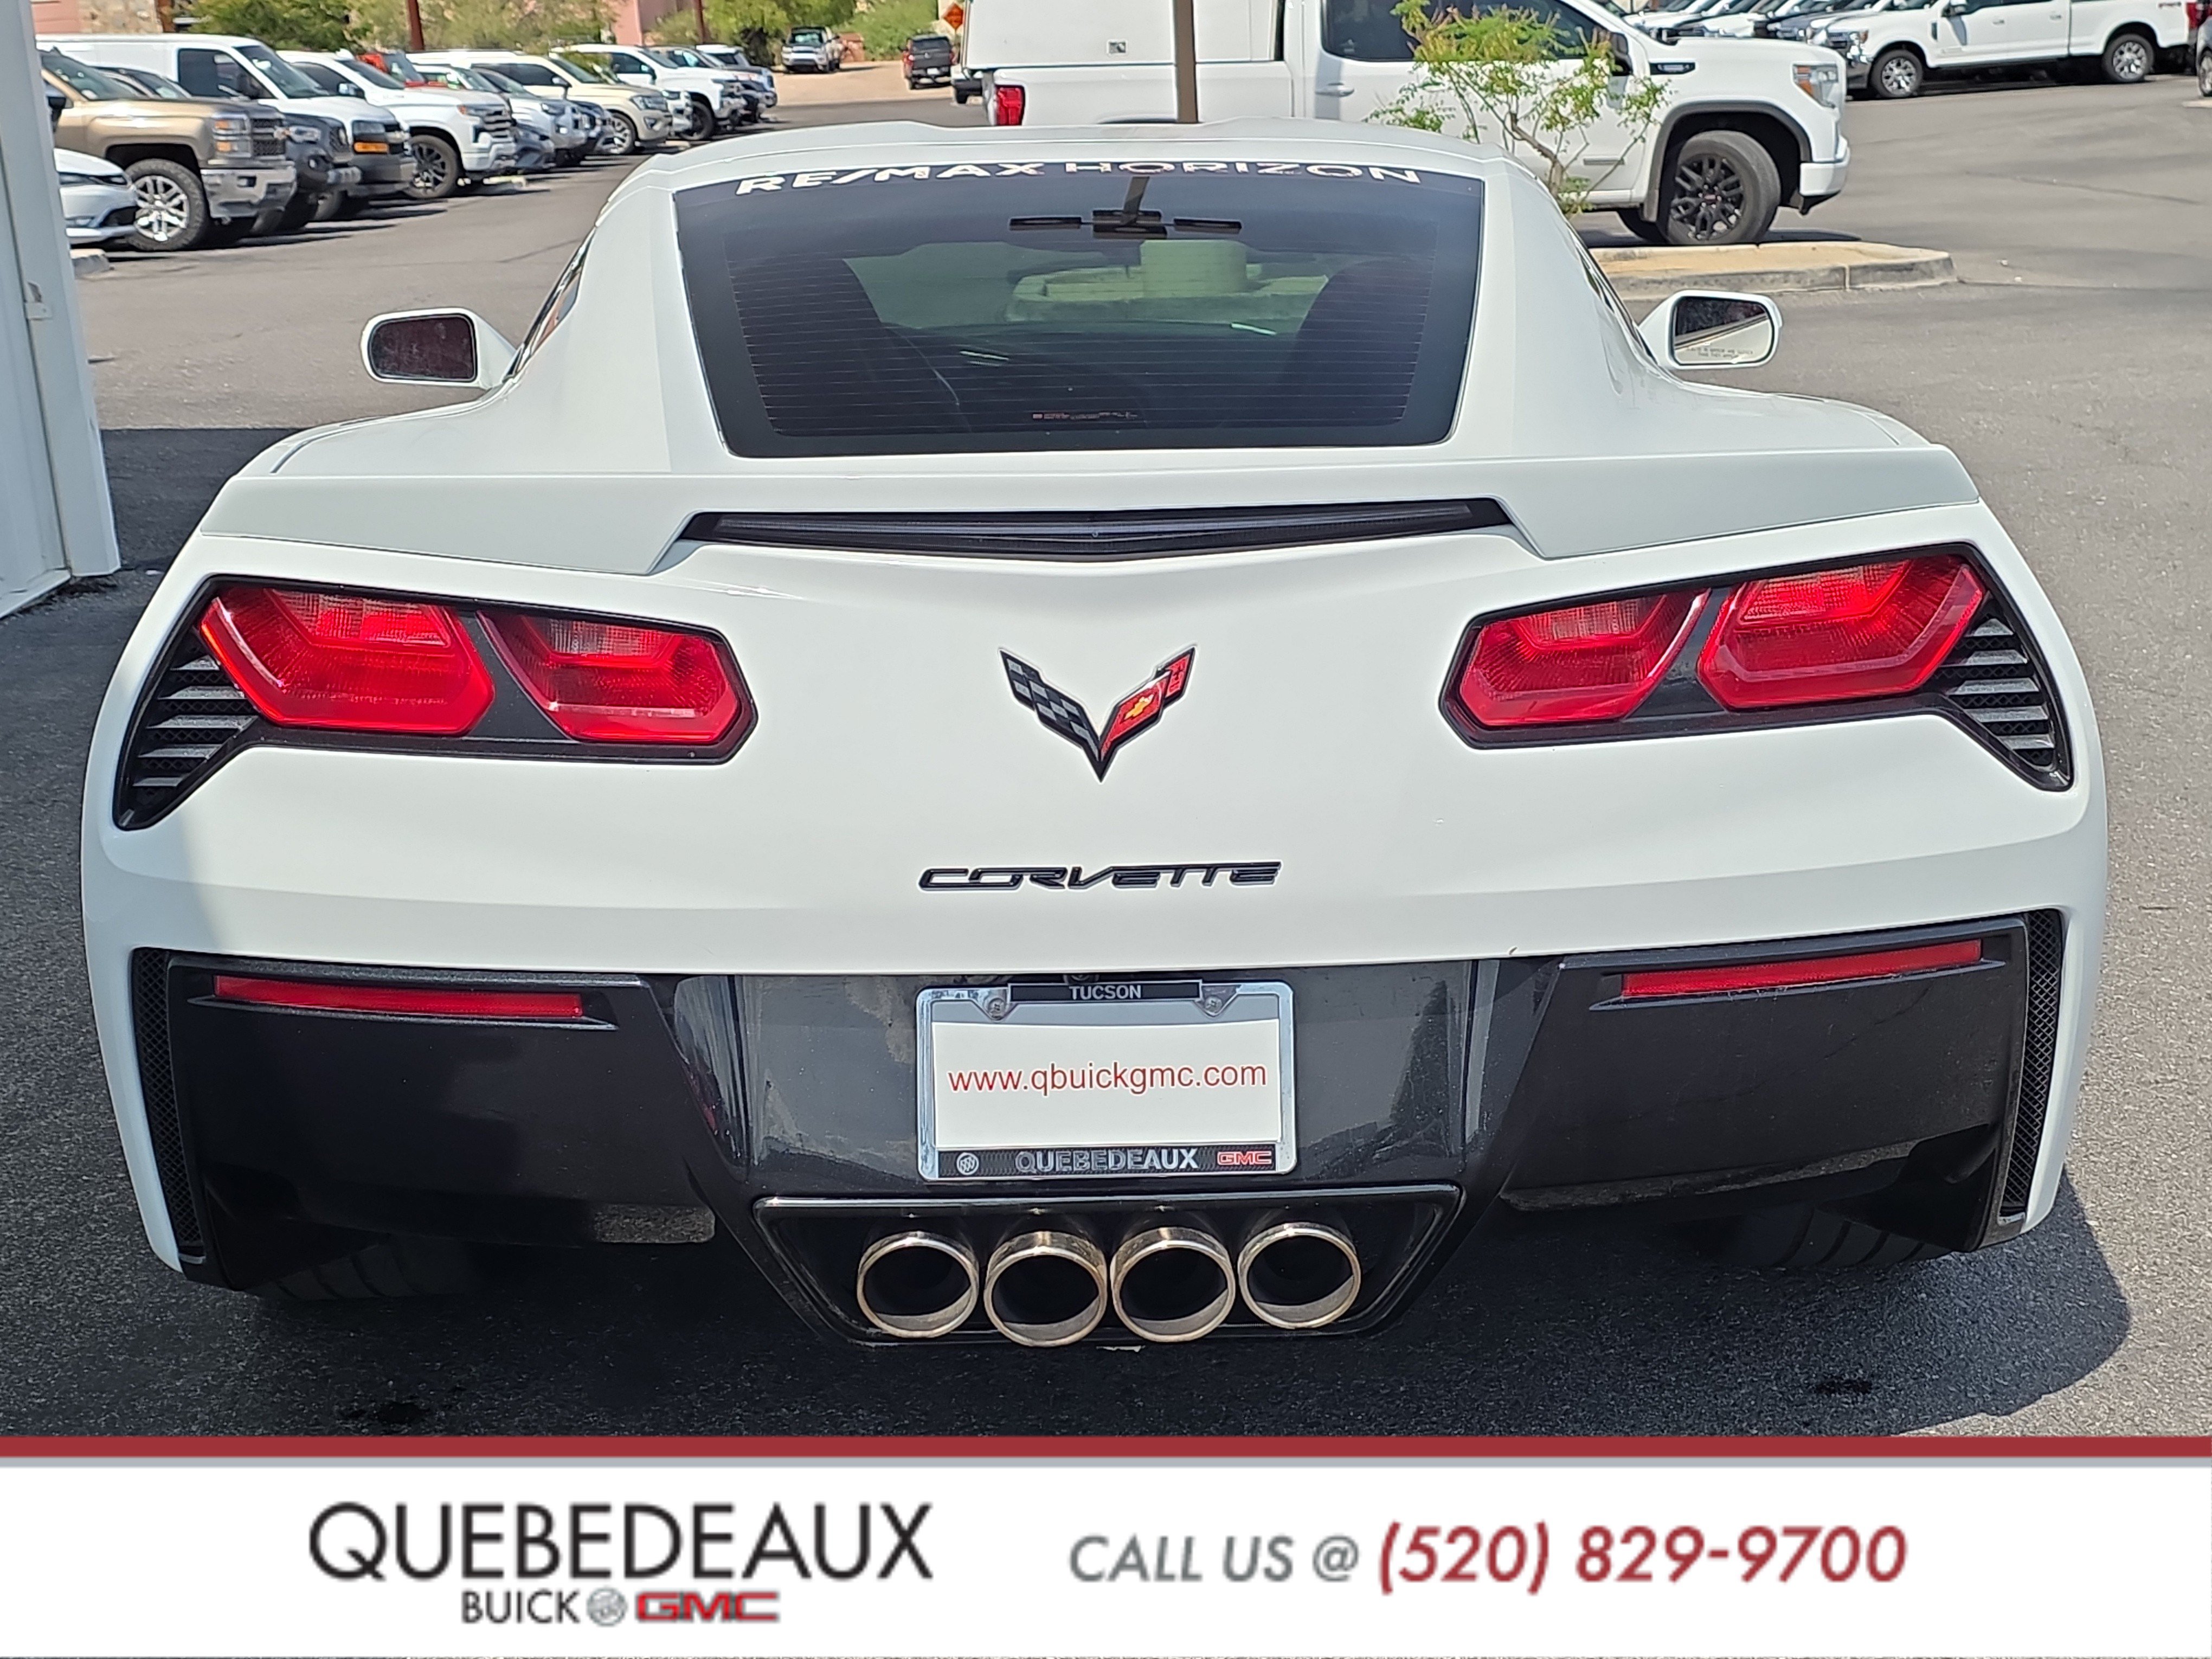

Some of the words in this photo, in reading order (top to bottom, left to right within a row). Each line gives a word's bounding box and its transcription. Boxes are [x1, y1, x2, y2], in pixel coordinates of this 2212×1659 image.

[735, 163, 1045, 195] RE/MAX
[1065, 162, 1422, 184] HORIZON
[919, 862, 1282, 890] CORVETTE
[1069, 985, 1142, 1000] TUCSON
[949, 1062, 1266, 1094] www.qbuickgmc.com
[1014, 1148, 1199, 1173] QUEBEDEAUX
[1217, 1151, 1272, 1166] GMC
